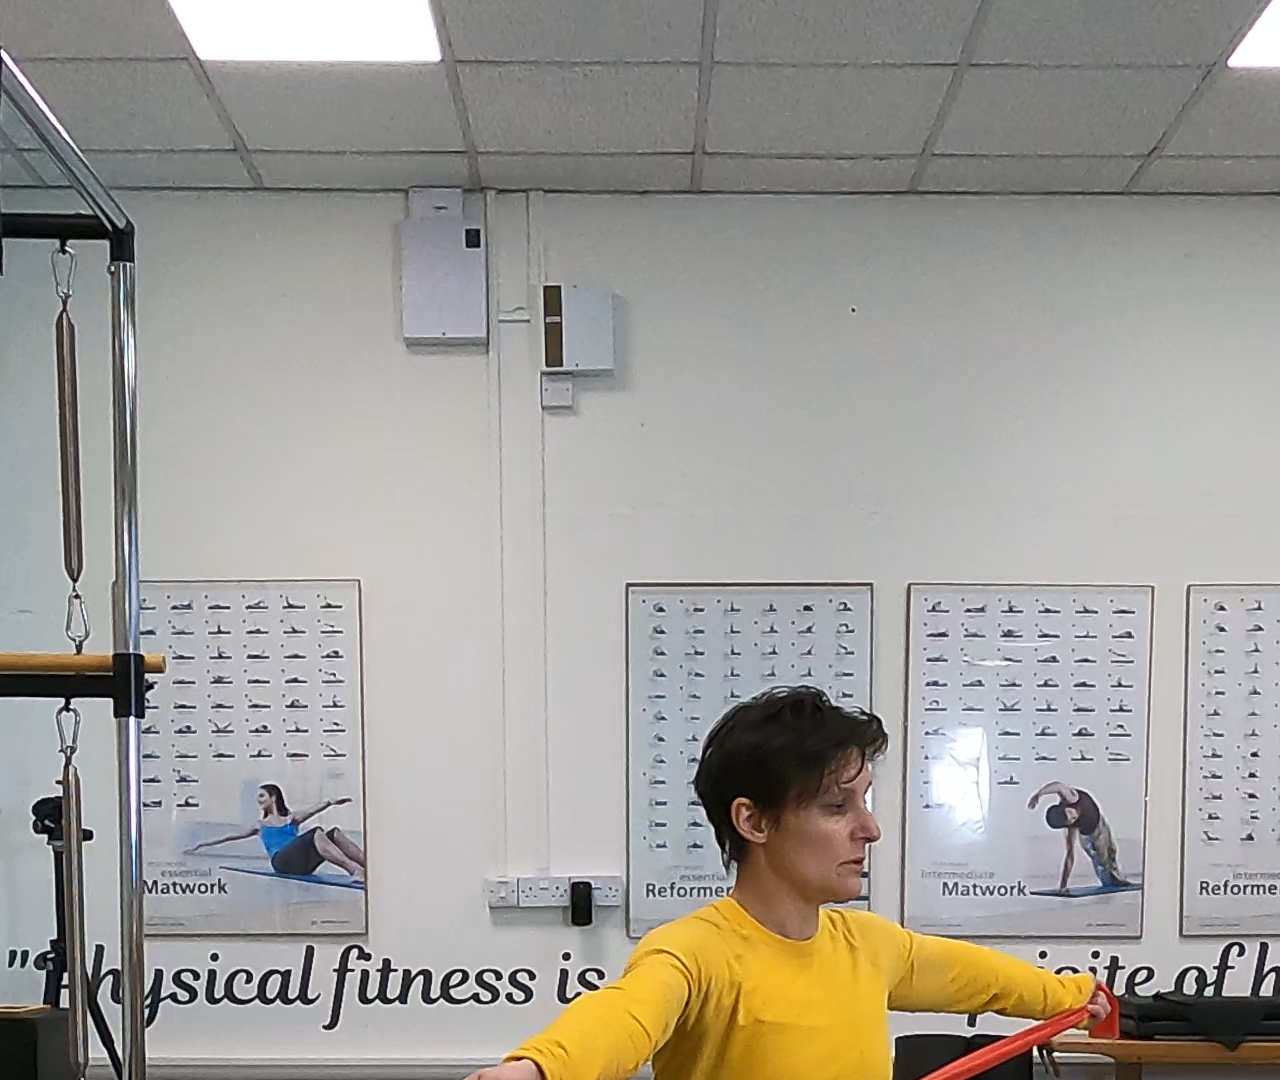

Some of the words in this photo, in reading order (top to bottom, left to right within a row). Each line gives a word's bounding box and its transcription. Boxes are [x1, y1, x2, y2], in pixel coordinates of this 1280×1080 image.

[142, 877, 229, 895] Matwork
[645, 881, 734, 899] Reformer
[941, 879, 1027, 897] Matwork
[7, 943, 322, 1029] "hysical
[321, 943, 538, 1031] fitness
[556, 951, 607, 1005] is
